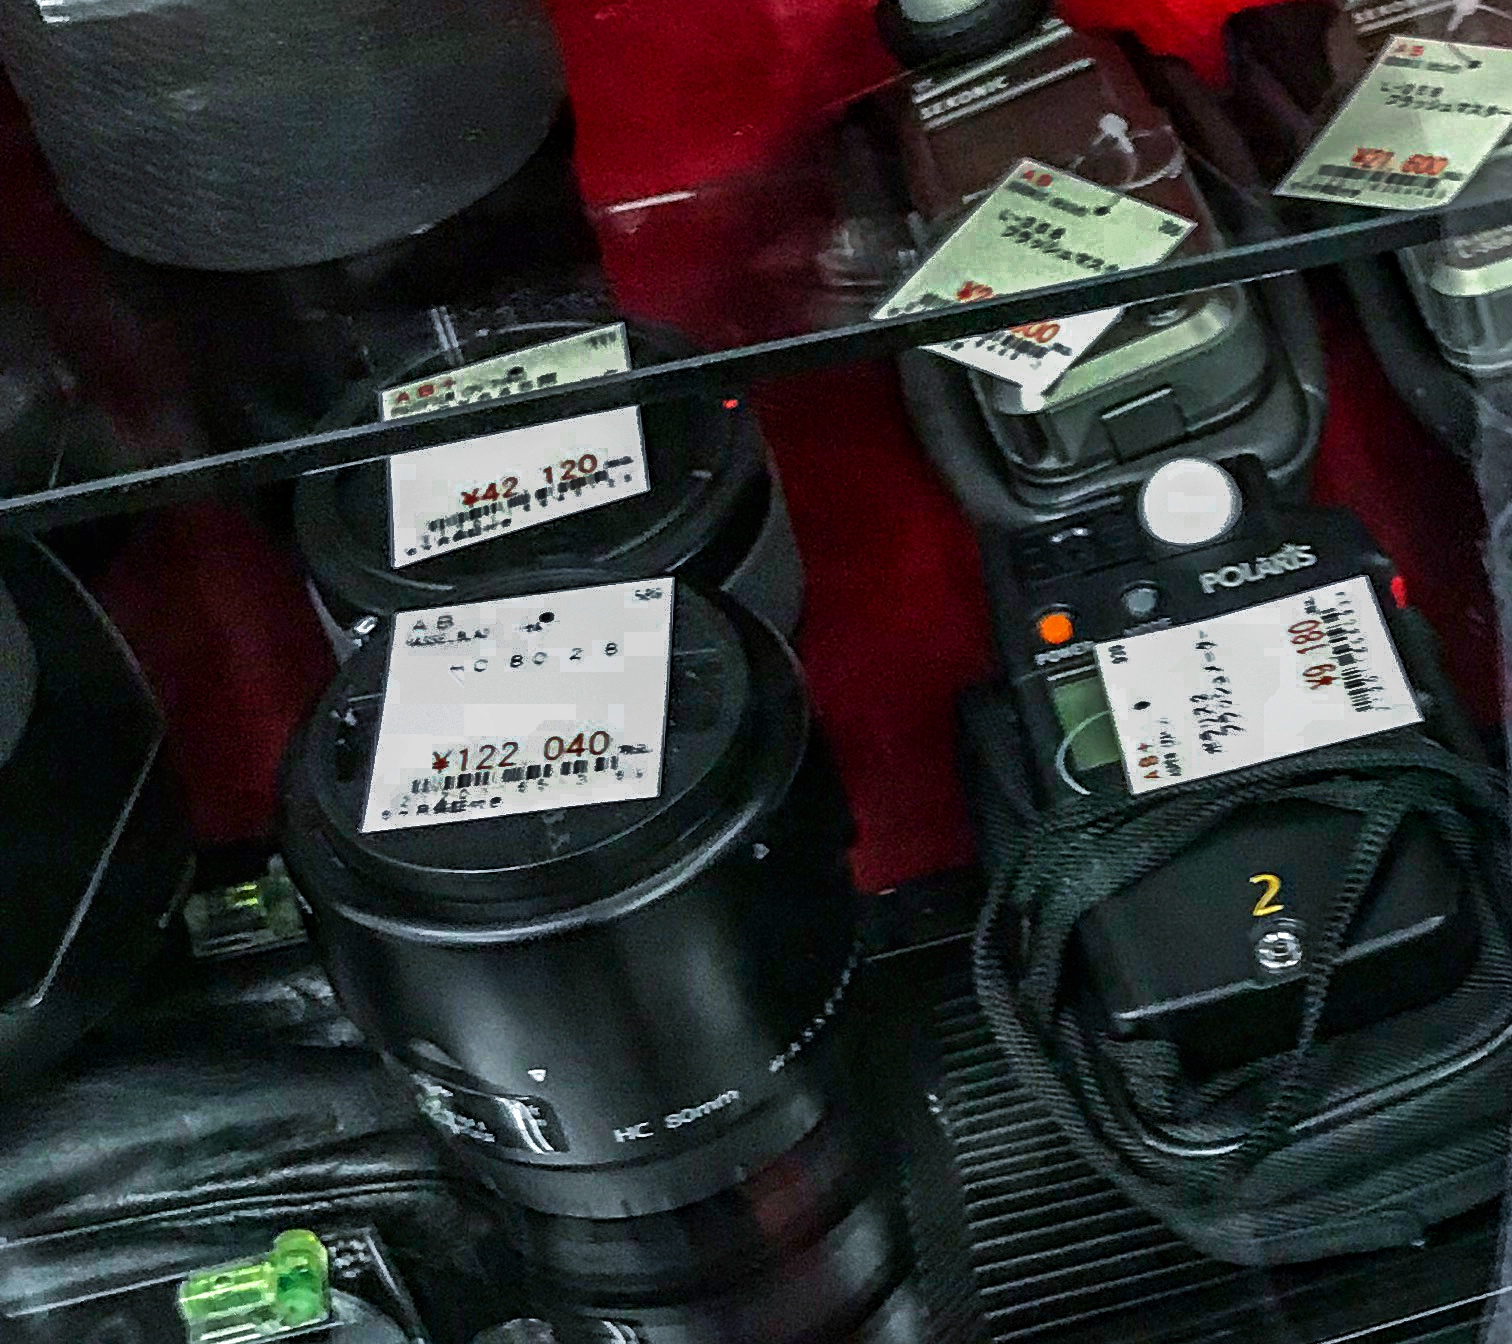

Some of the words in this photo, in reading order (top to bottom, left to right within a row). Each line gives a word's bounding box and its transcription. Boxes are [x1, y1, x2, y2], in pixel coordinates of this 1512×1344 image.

[460, 475, 520, 507] ¥42
[542, 452, 599, 485] 120
[1199, 542, 1318, 595] POLARIS
[1286, 618, 1328, 656] 180
[431, 739, 521, 773] ¥122
[542, 729, 612, 762] 040
[1249, 873, 1285, 918] 2
[613, 1121, 656, 1144] HC
